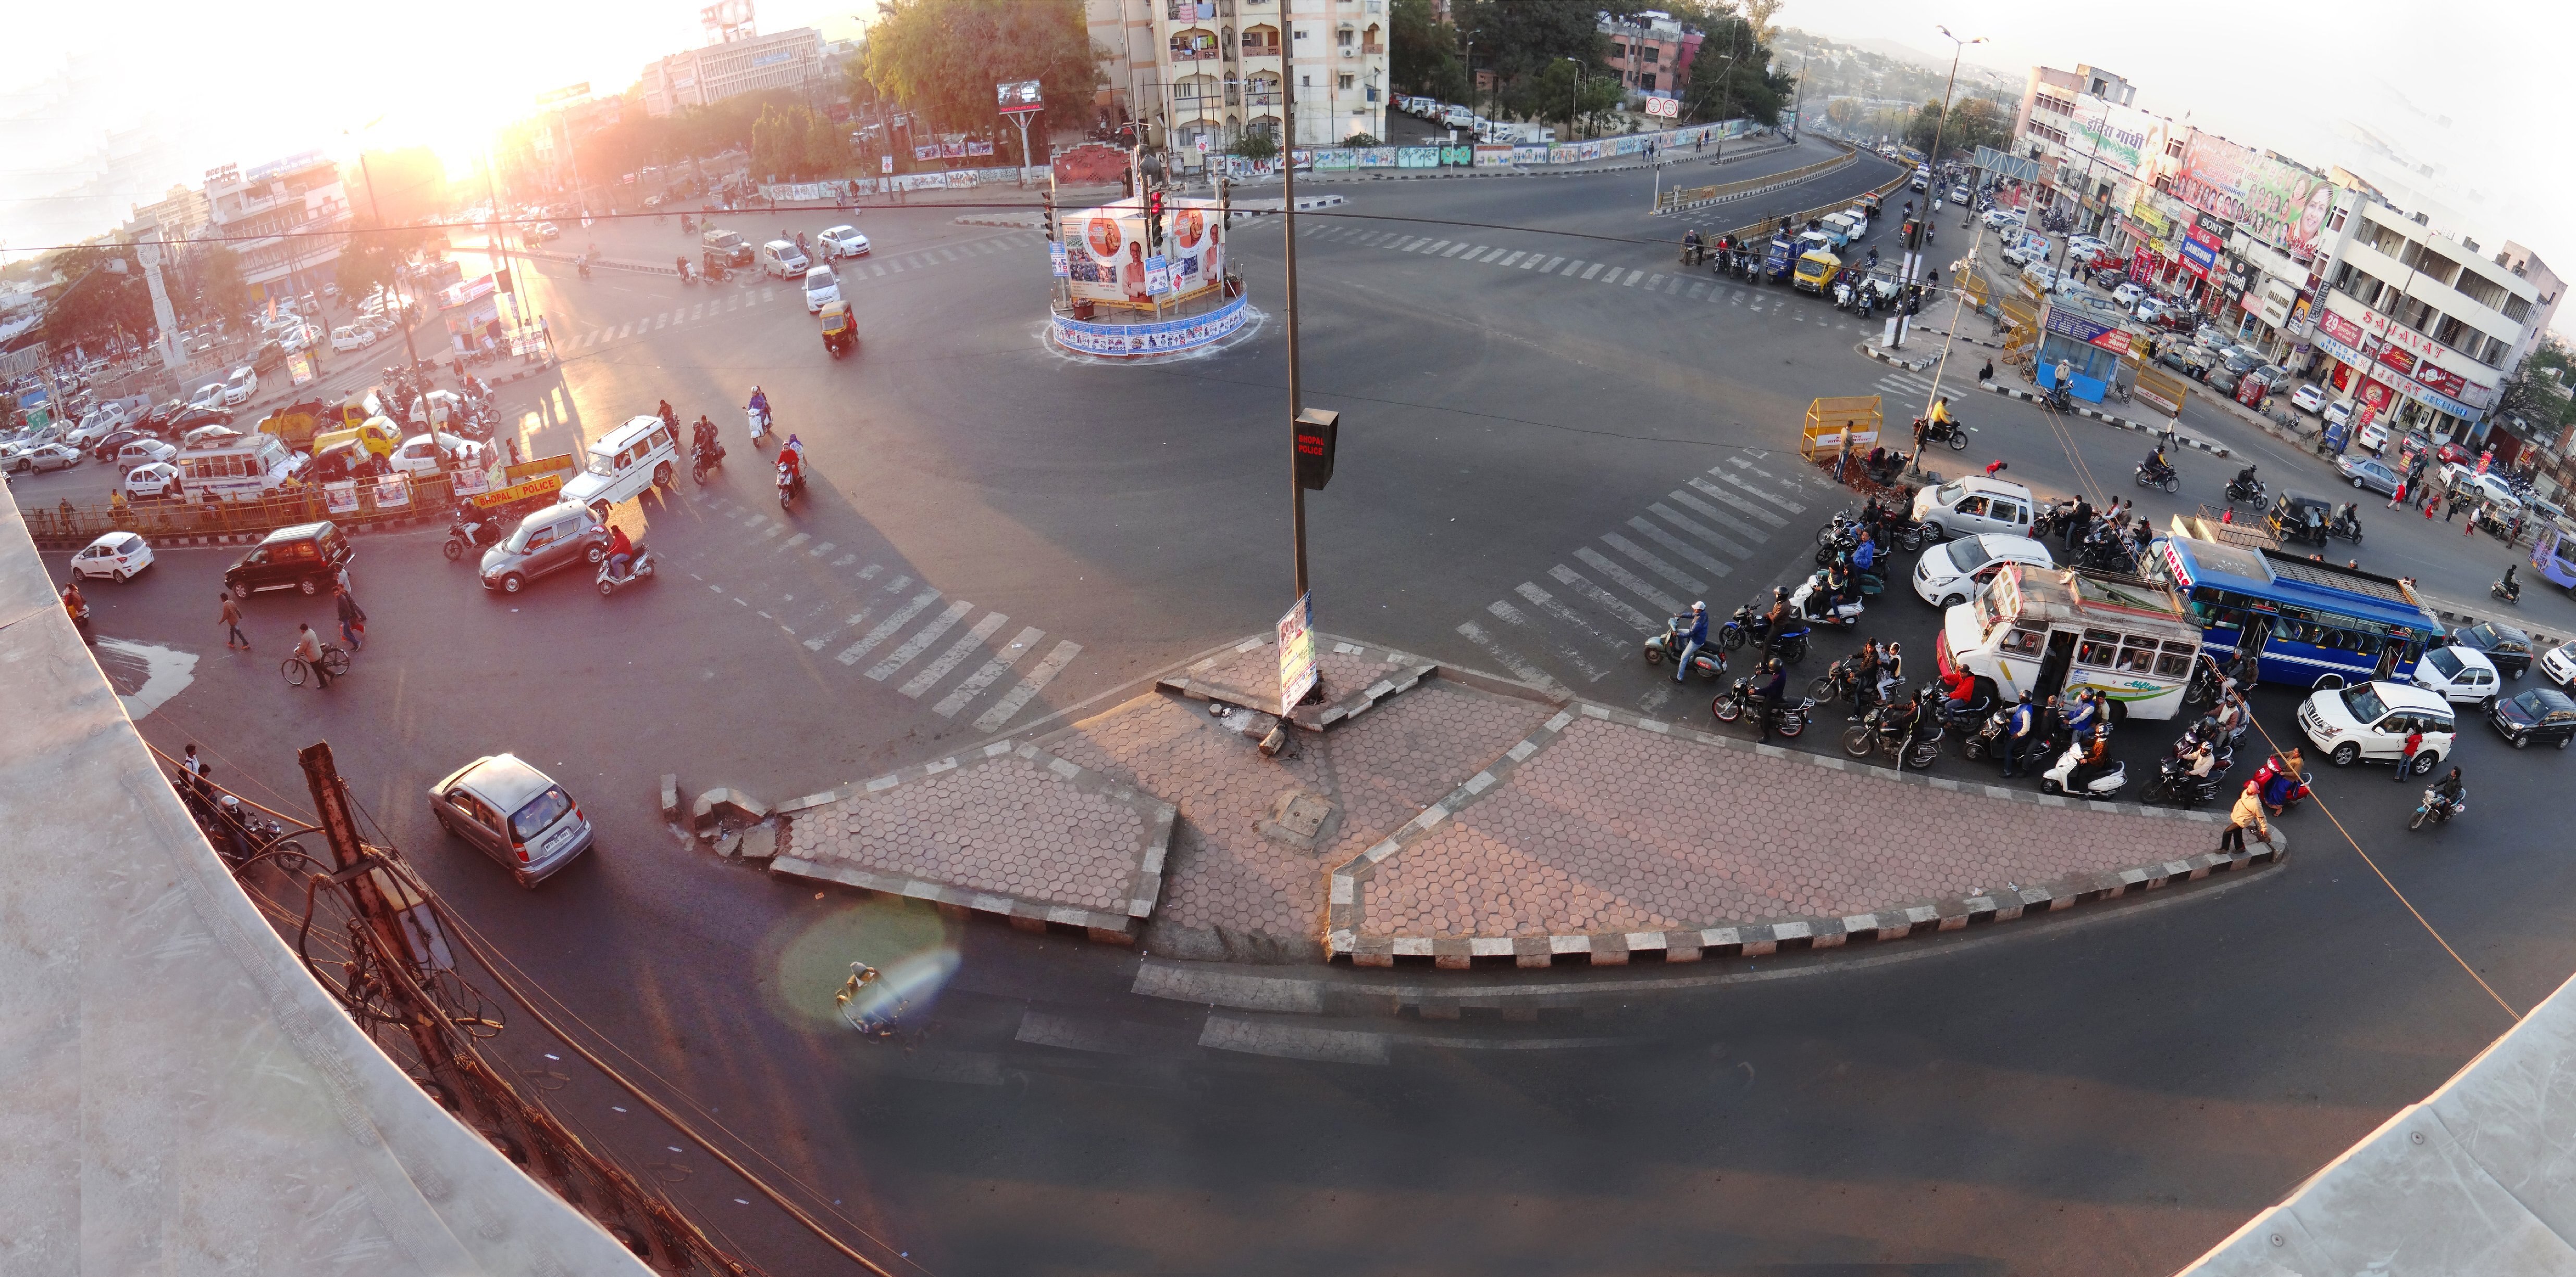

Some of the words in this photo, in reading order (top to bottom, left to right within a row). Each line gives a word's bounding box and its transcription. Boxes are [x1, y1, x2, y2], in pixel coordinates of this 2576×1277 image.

[2087, 115, 2115, 138] इंदिरा
[2115, 128, 2145, 150] गांधी
[205, 167, 219, 178] BCC
[221, 162, 238, 173] Bank
[2206, 167, 2228, 181] जन्मदिन
[2200, 217, 2226, 235] SONY
[2185, 241, 2212, 264] SAMSUNG
[2325, 314, 2338, 330] 29
[2363, 311, 2445, 359] SAJAVAT
[2366, 404, 2374, 413] 29
[1298, 434, 1324, 446] BHOPAL
[1298, 444, 1323, 456] POLICE
[479, 491, 512, 507] BHOPAL
[523, 479, 555, 495] POLICE
